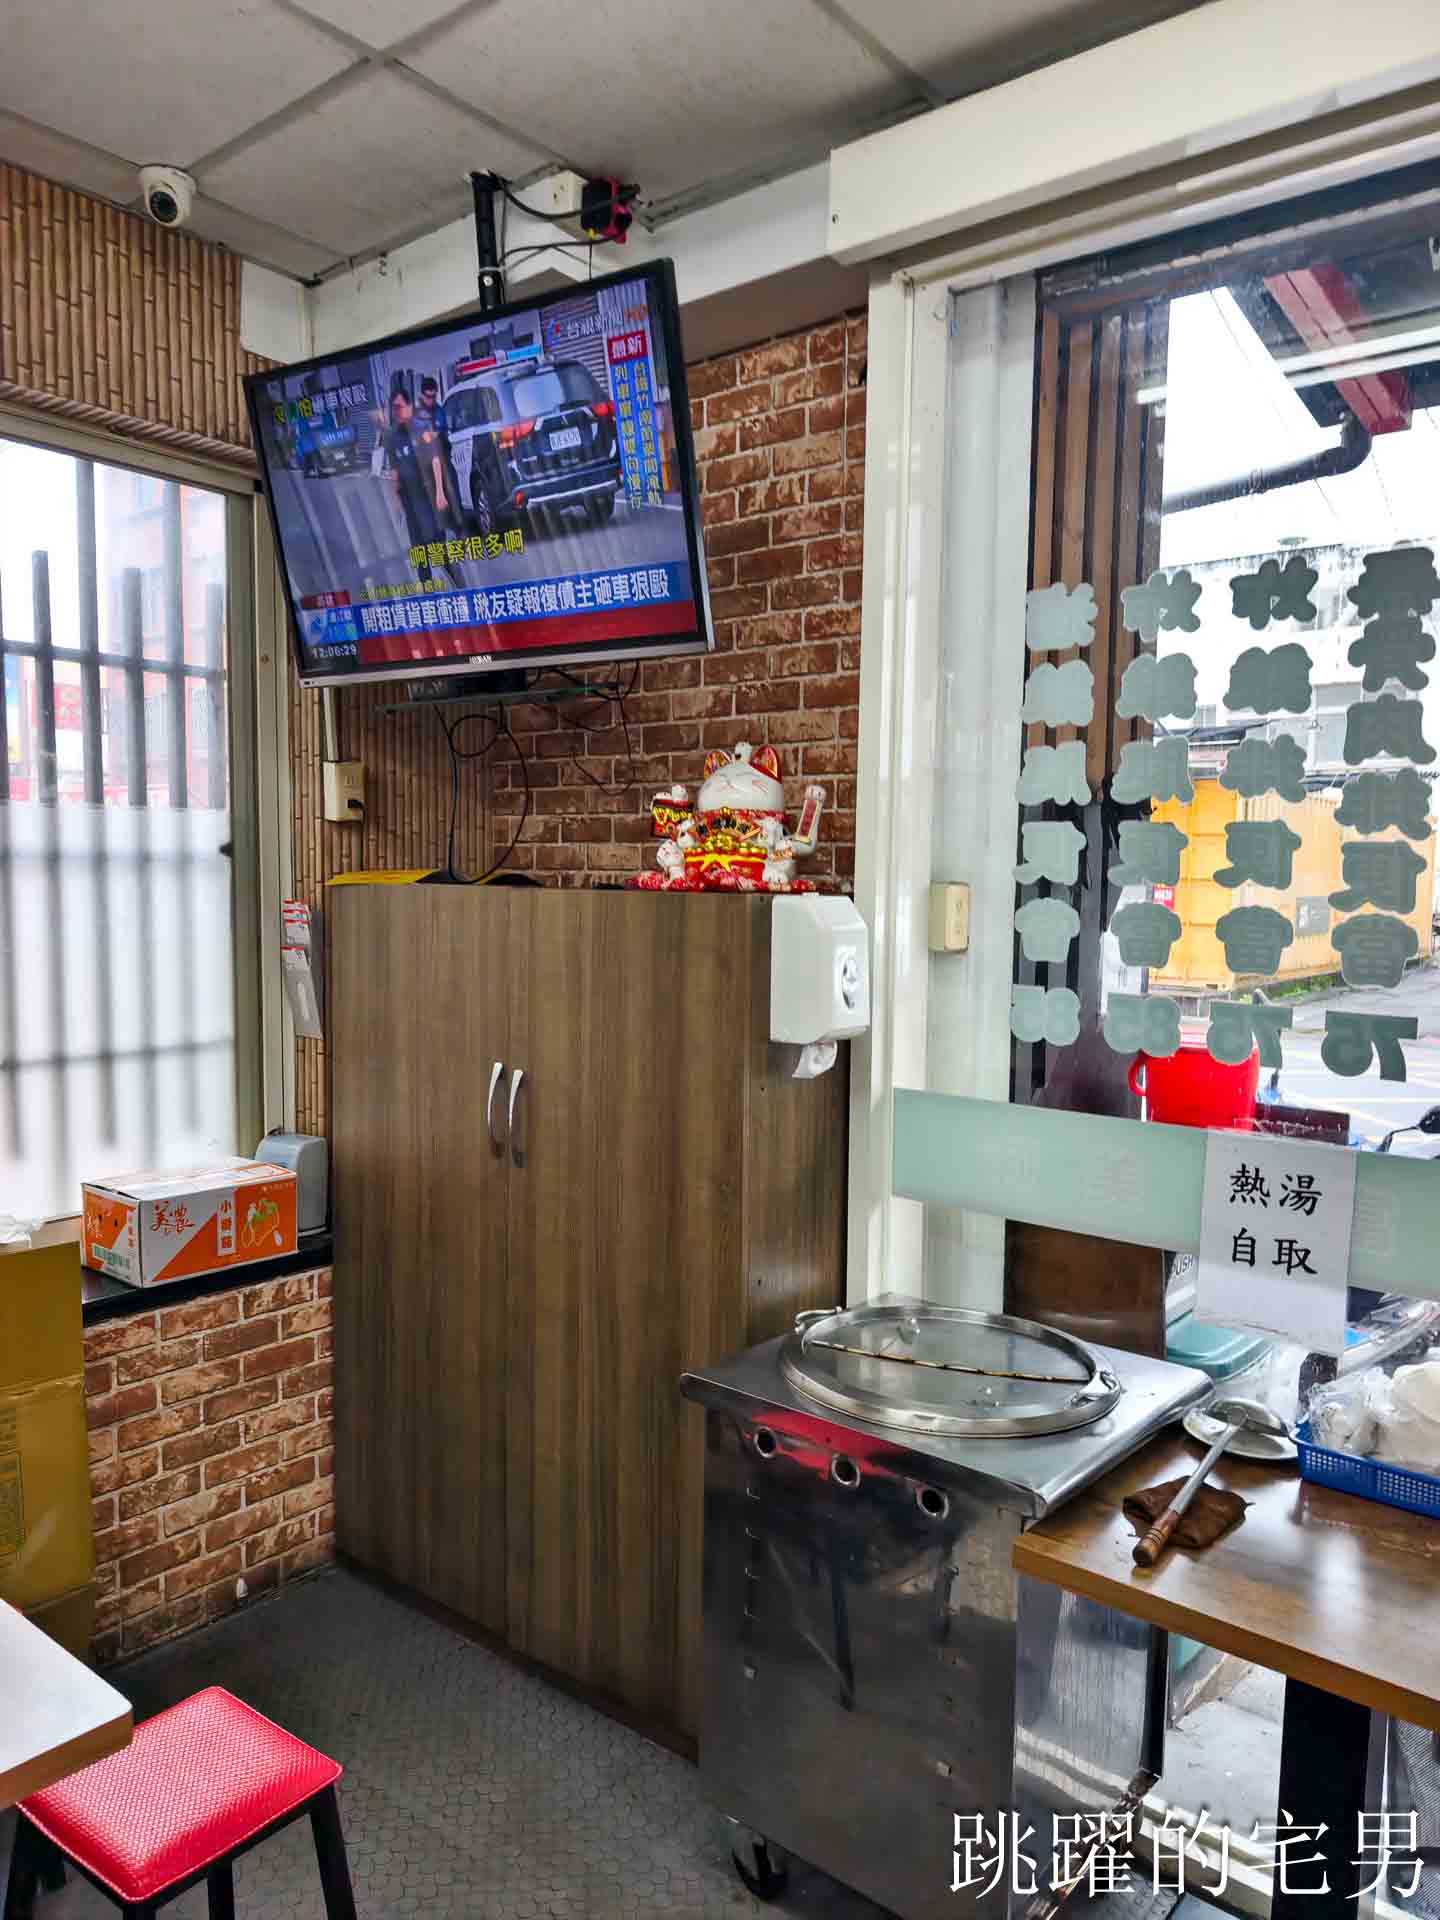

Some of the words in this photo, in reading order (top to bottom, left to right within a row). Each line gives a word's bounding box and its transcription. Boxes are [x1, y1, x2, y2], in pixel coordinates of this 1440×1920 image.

[409, 528, 525, 569] 啊警察很多啊
[360, 595, 471, 634] 開租賃貨車衝撞
[1229, 1162, 1323, 1217] 熱湯
[1231, 1226, 1318, 1277] 自取
